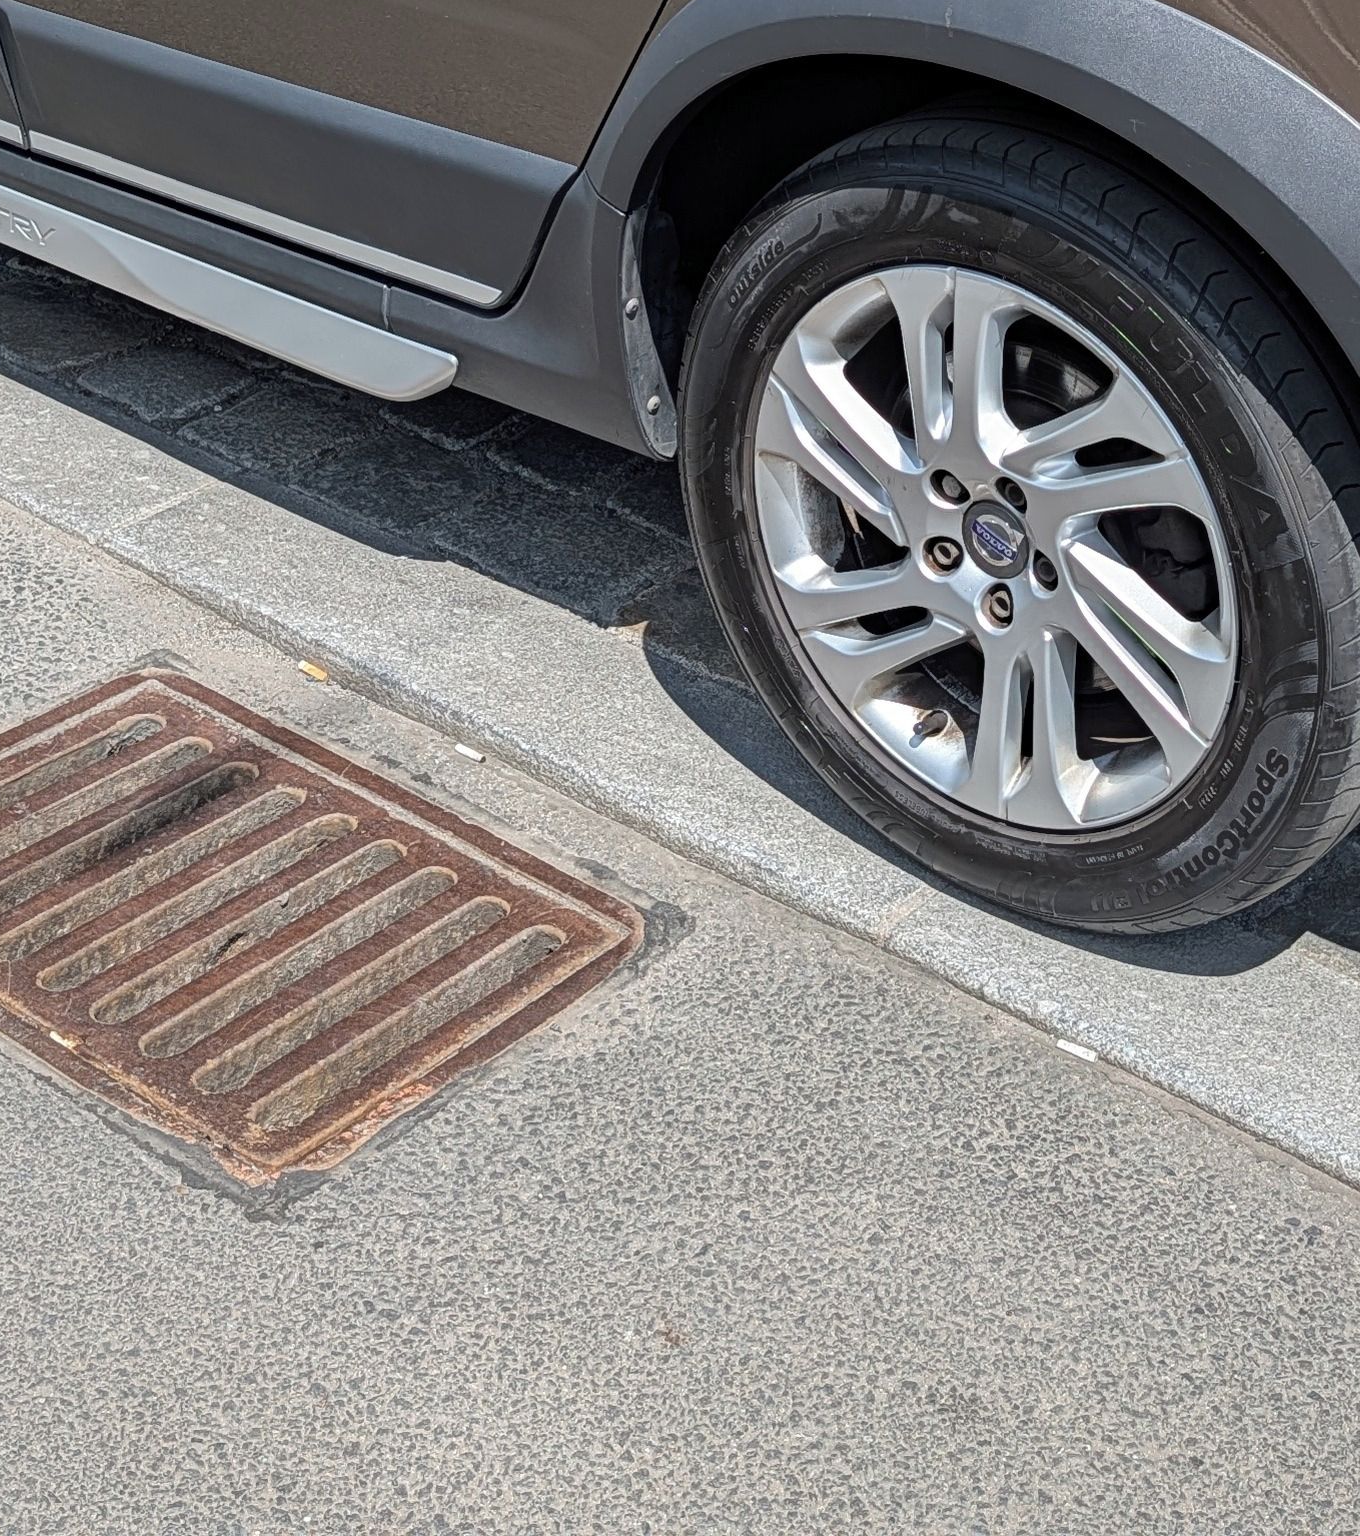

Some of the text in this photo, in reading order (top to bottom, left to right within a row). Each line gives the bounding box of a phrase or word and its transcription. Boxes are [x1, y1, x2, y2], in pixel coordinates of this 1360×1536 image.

[727, 237, 786, 309] outside
[974, 522, 1014, 559] VOLVO
[1139, 746, 1290, 906] SportControl
